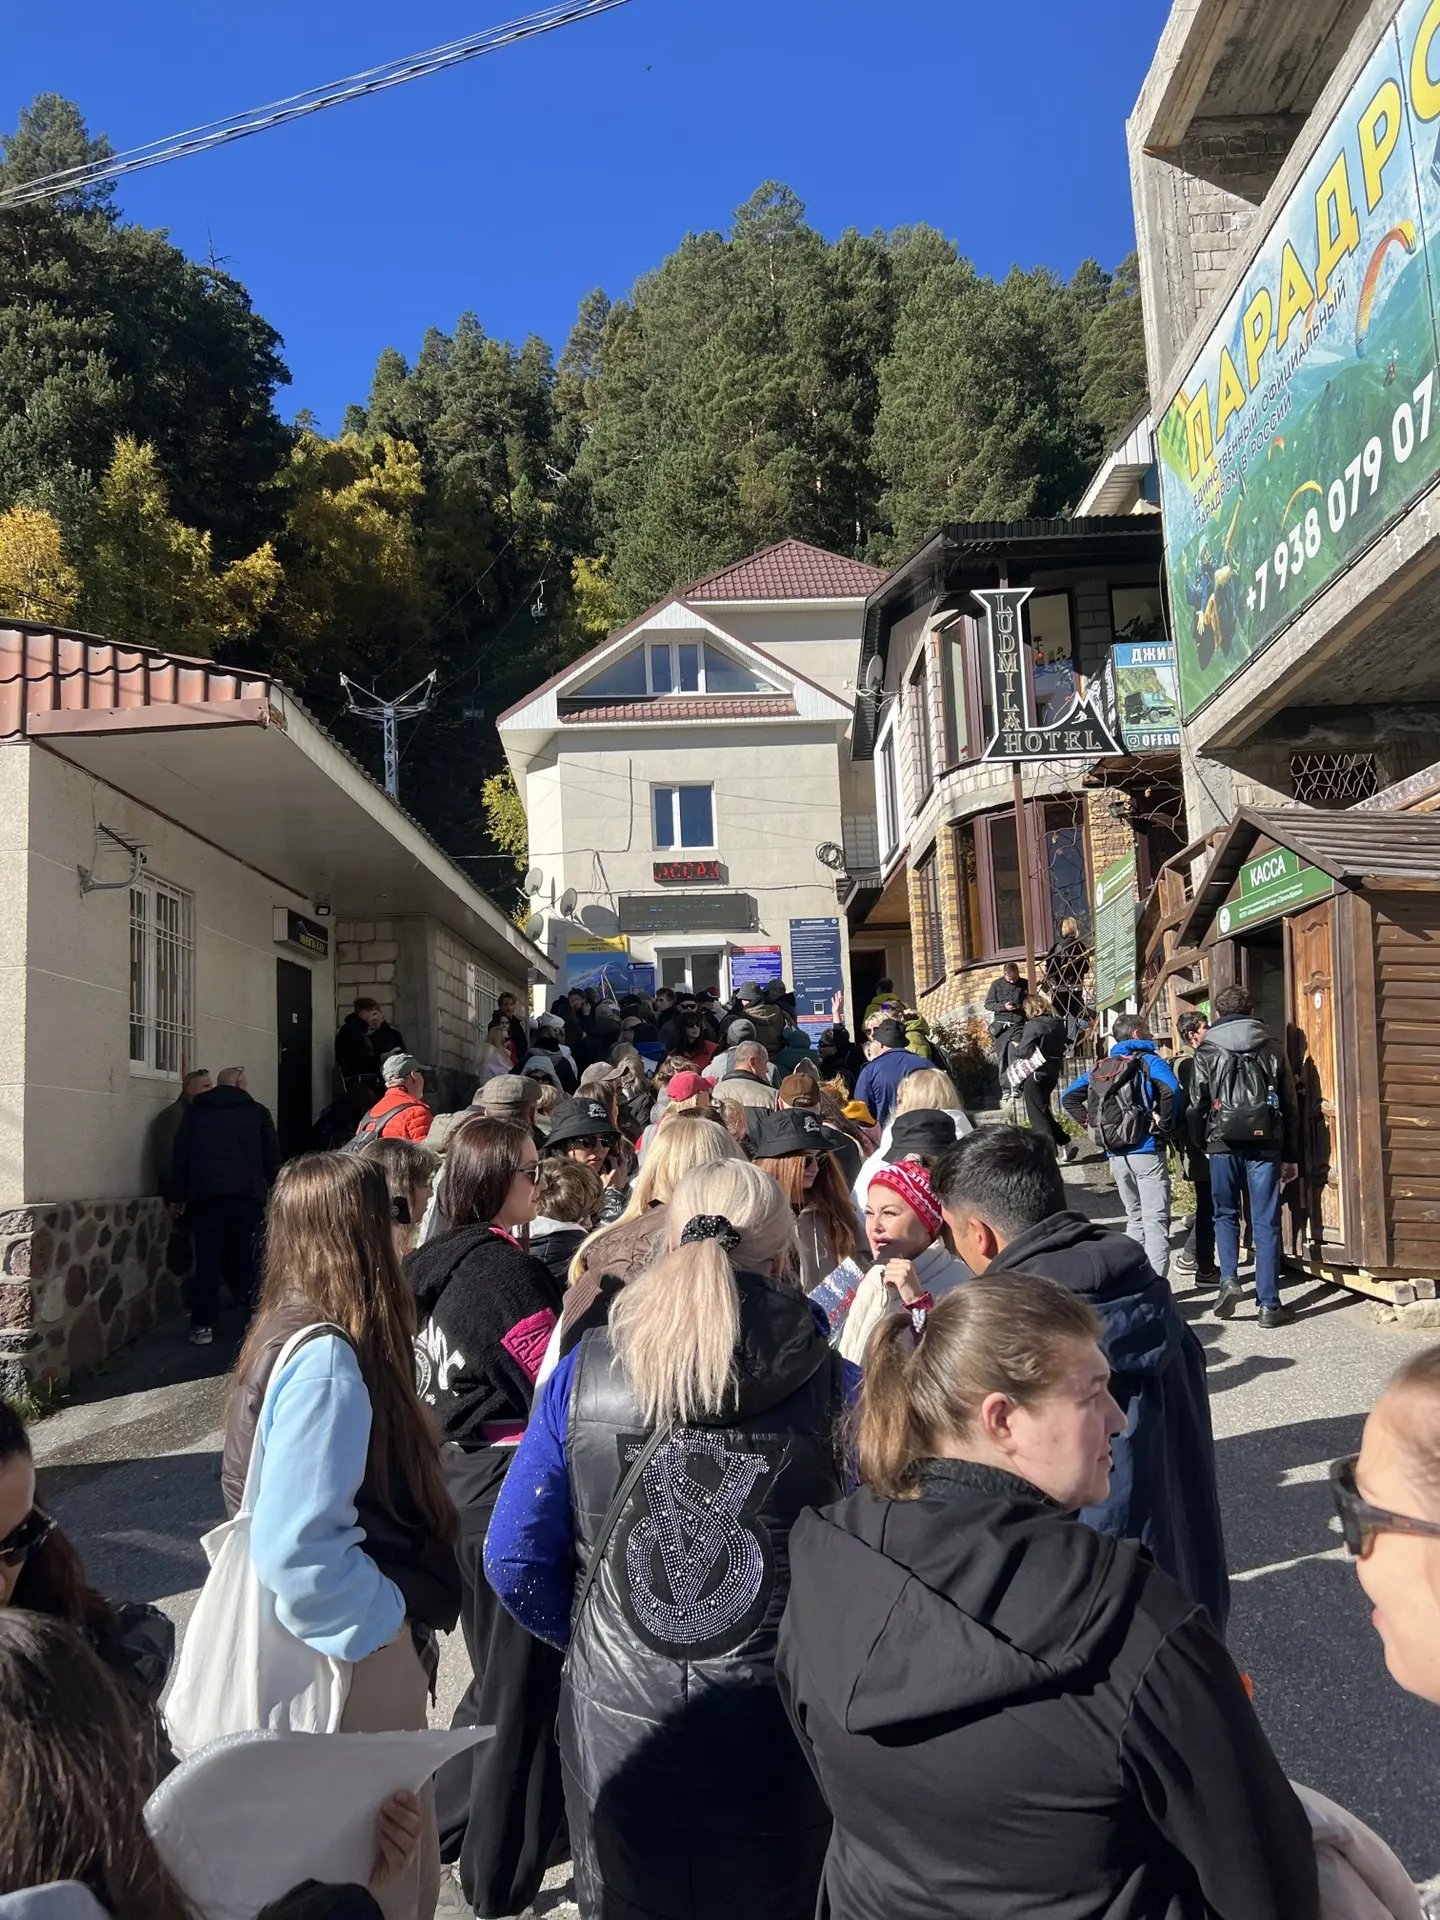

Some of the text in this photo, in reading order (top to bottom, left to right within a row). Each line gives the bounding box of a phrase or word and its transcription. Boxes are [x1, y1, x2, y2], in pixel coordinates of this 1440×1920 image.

[1193, 276, 1347, 510] ЕДИНСТВЕННЫЙ ОФИЦИАЛЬНЫЙ
[1194, 393, 1293, 531] ПАРАДРОМ В РОССИИ
[1246, 369, 1434, 612] +7 938 079 07
[995, 594, 1024, 732] LUDMILA
[1004, 729, 1103, 754] HOTEL
[1250, 854, 1287, 888] КАССА
